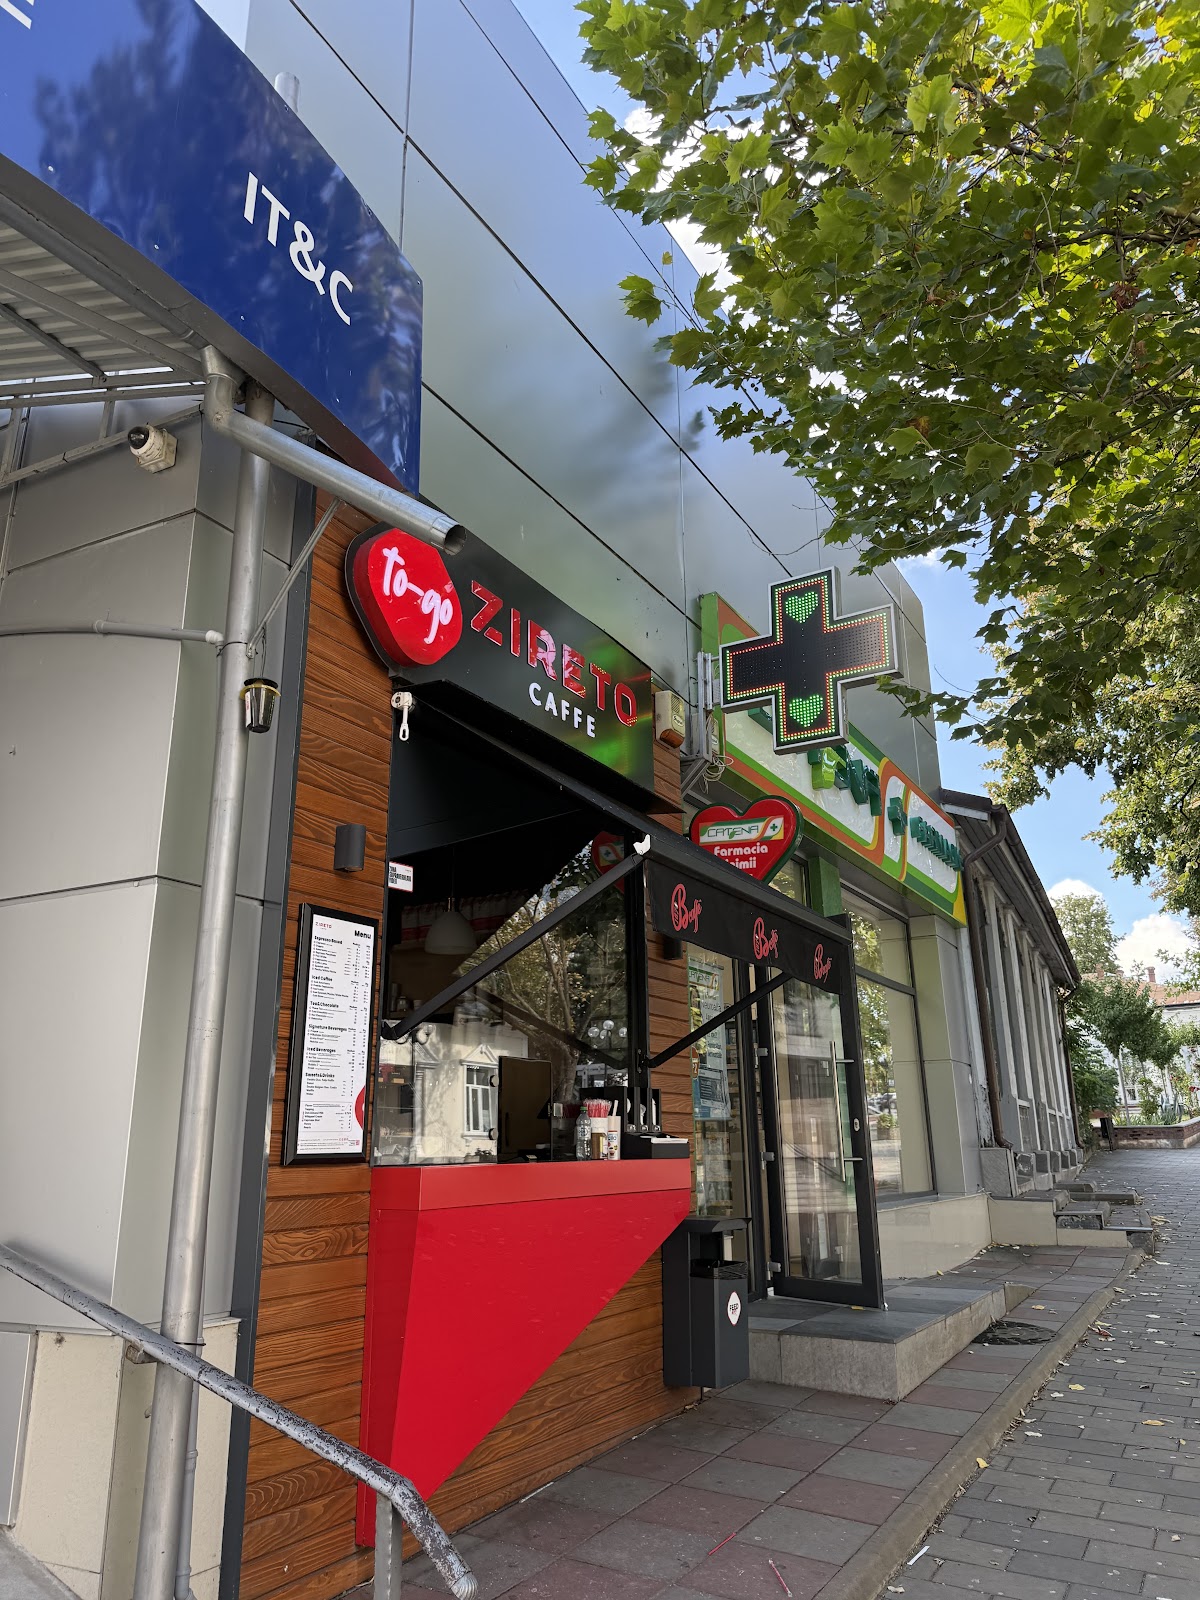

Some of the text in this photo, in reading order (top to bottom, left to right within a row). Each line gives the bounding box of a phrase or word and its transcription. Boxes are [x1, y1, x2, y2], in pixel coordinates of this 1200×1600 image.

[243, 171, 354, 326] IT&C
[382, 546, 453, 645] to-go
[470, 579, 638, 728] ZIRETO
[528, 681, 597, 739] CAFFE
[707, 825, 759, 839] CATENA
[713, 842, 769, 857] Farmacia
[354, 930, 371, 939] Menu
